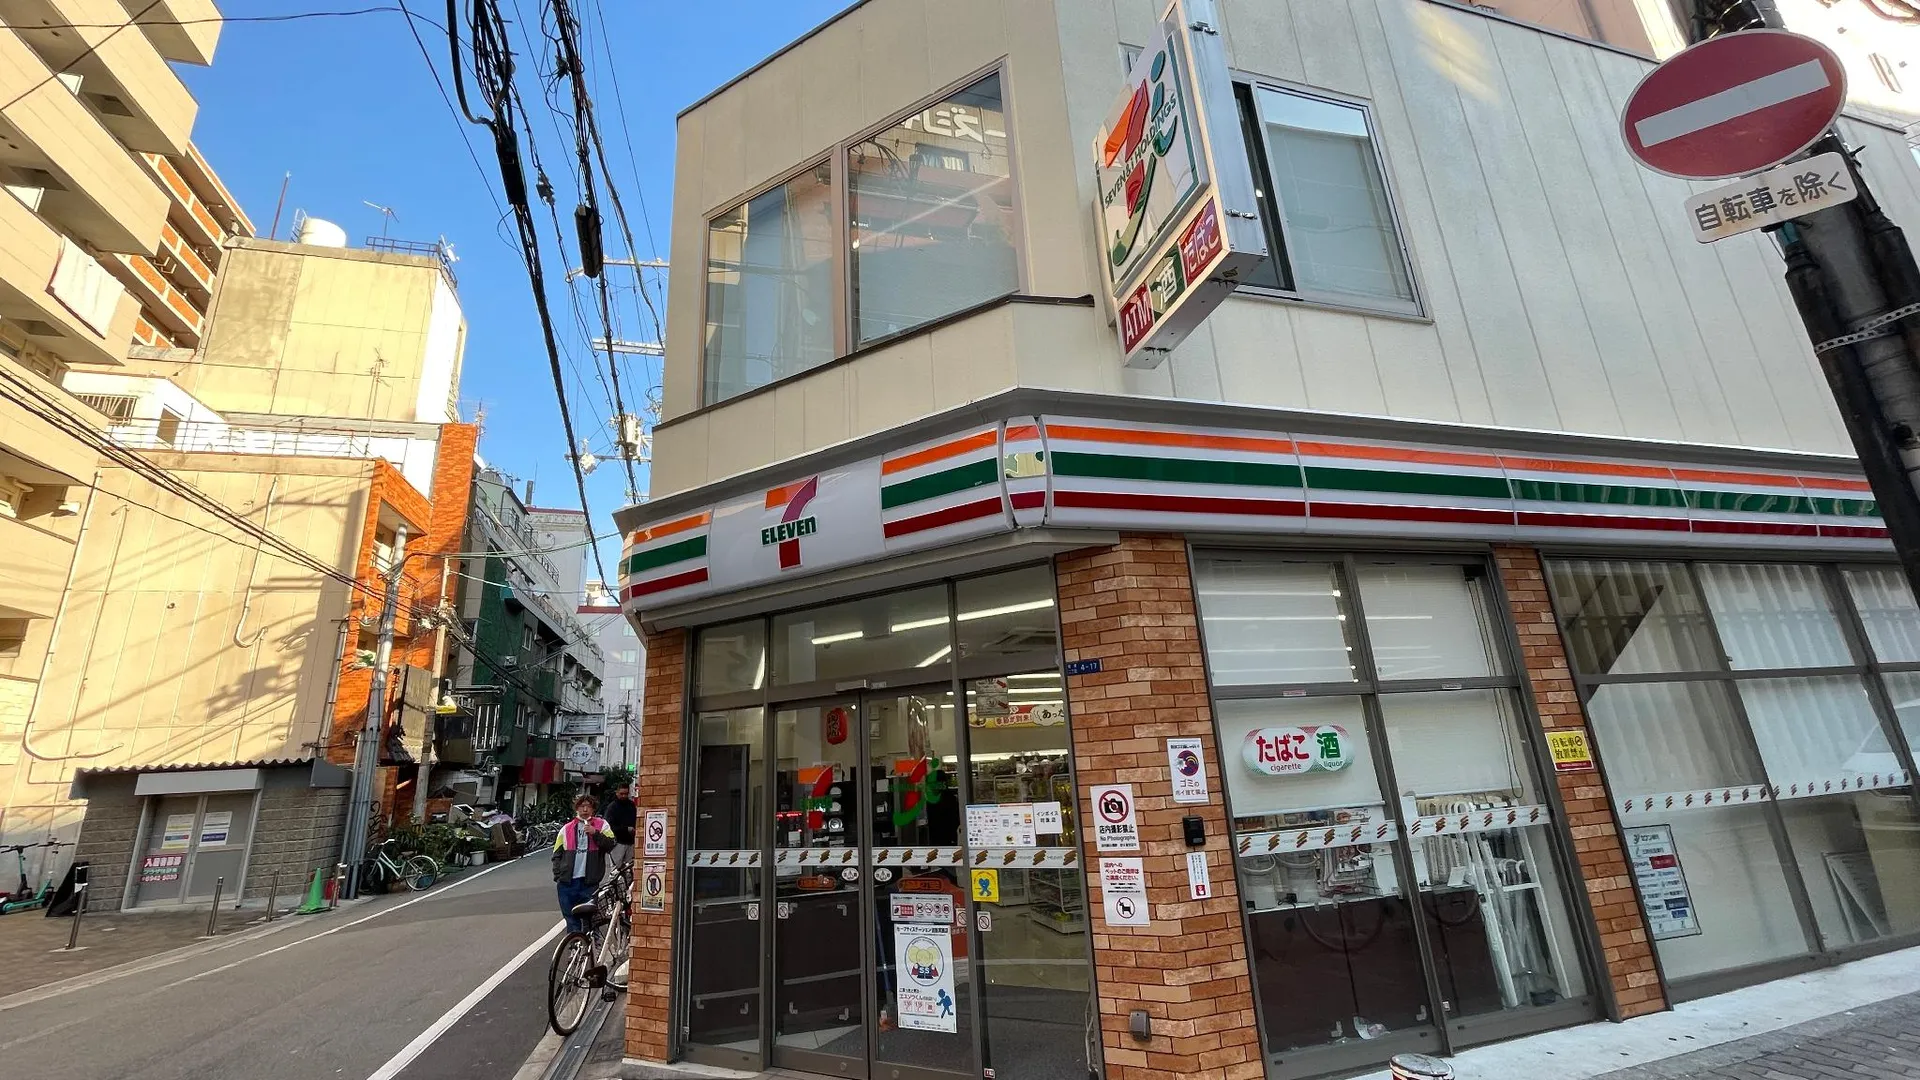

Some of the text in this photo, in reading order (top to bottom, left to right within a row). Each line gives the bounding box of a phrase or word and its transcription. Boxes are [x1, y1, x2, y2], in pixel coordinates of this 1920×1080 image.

[1134, 93, 1177, 166] HOLDINGS
[1695, 171, 1847, 231] 自転車を除く
[1184, 214, 1220, 277] たばこ
[1155, 256, 1179, 308] 酒
[1124, 299, 1153, 346] ATM
[1256, 731, 1341, 763] たばこ 酒
[1270, 760, 1343, 773] cigarette liquor
[1551, 737, 1575, 748] 自転車
